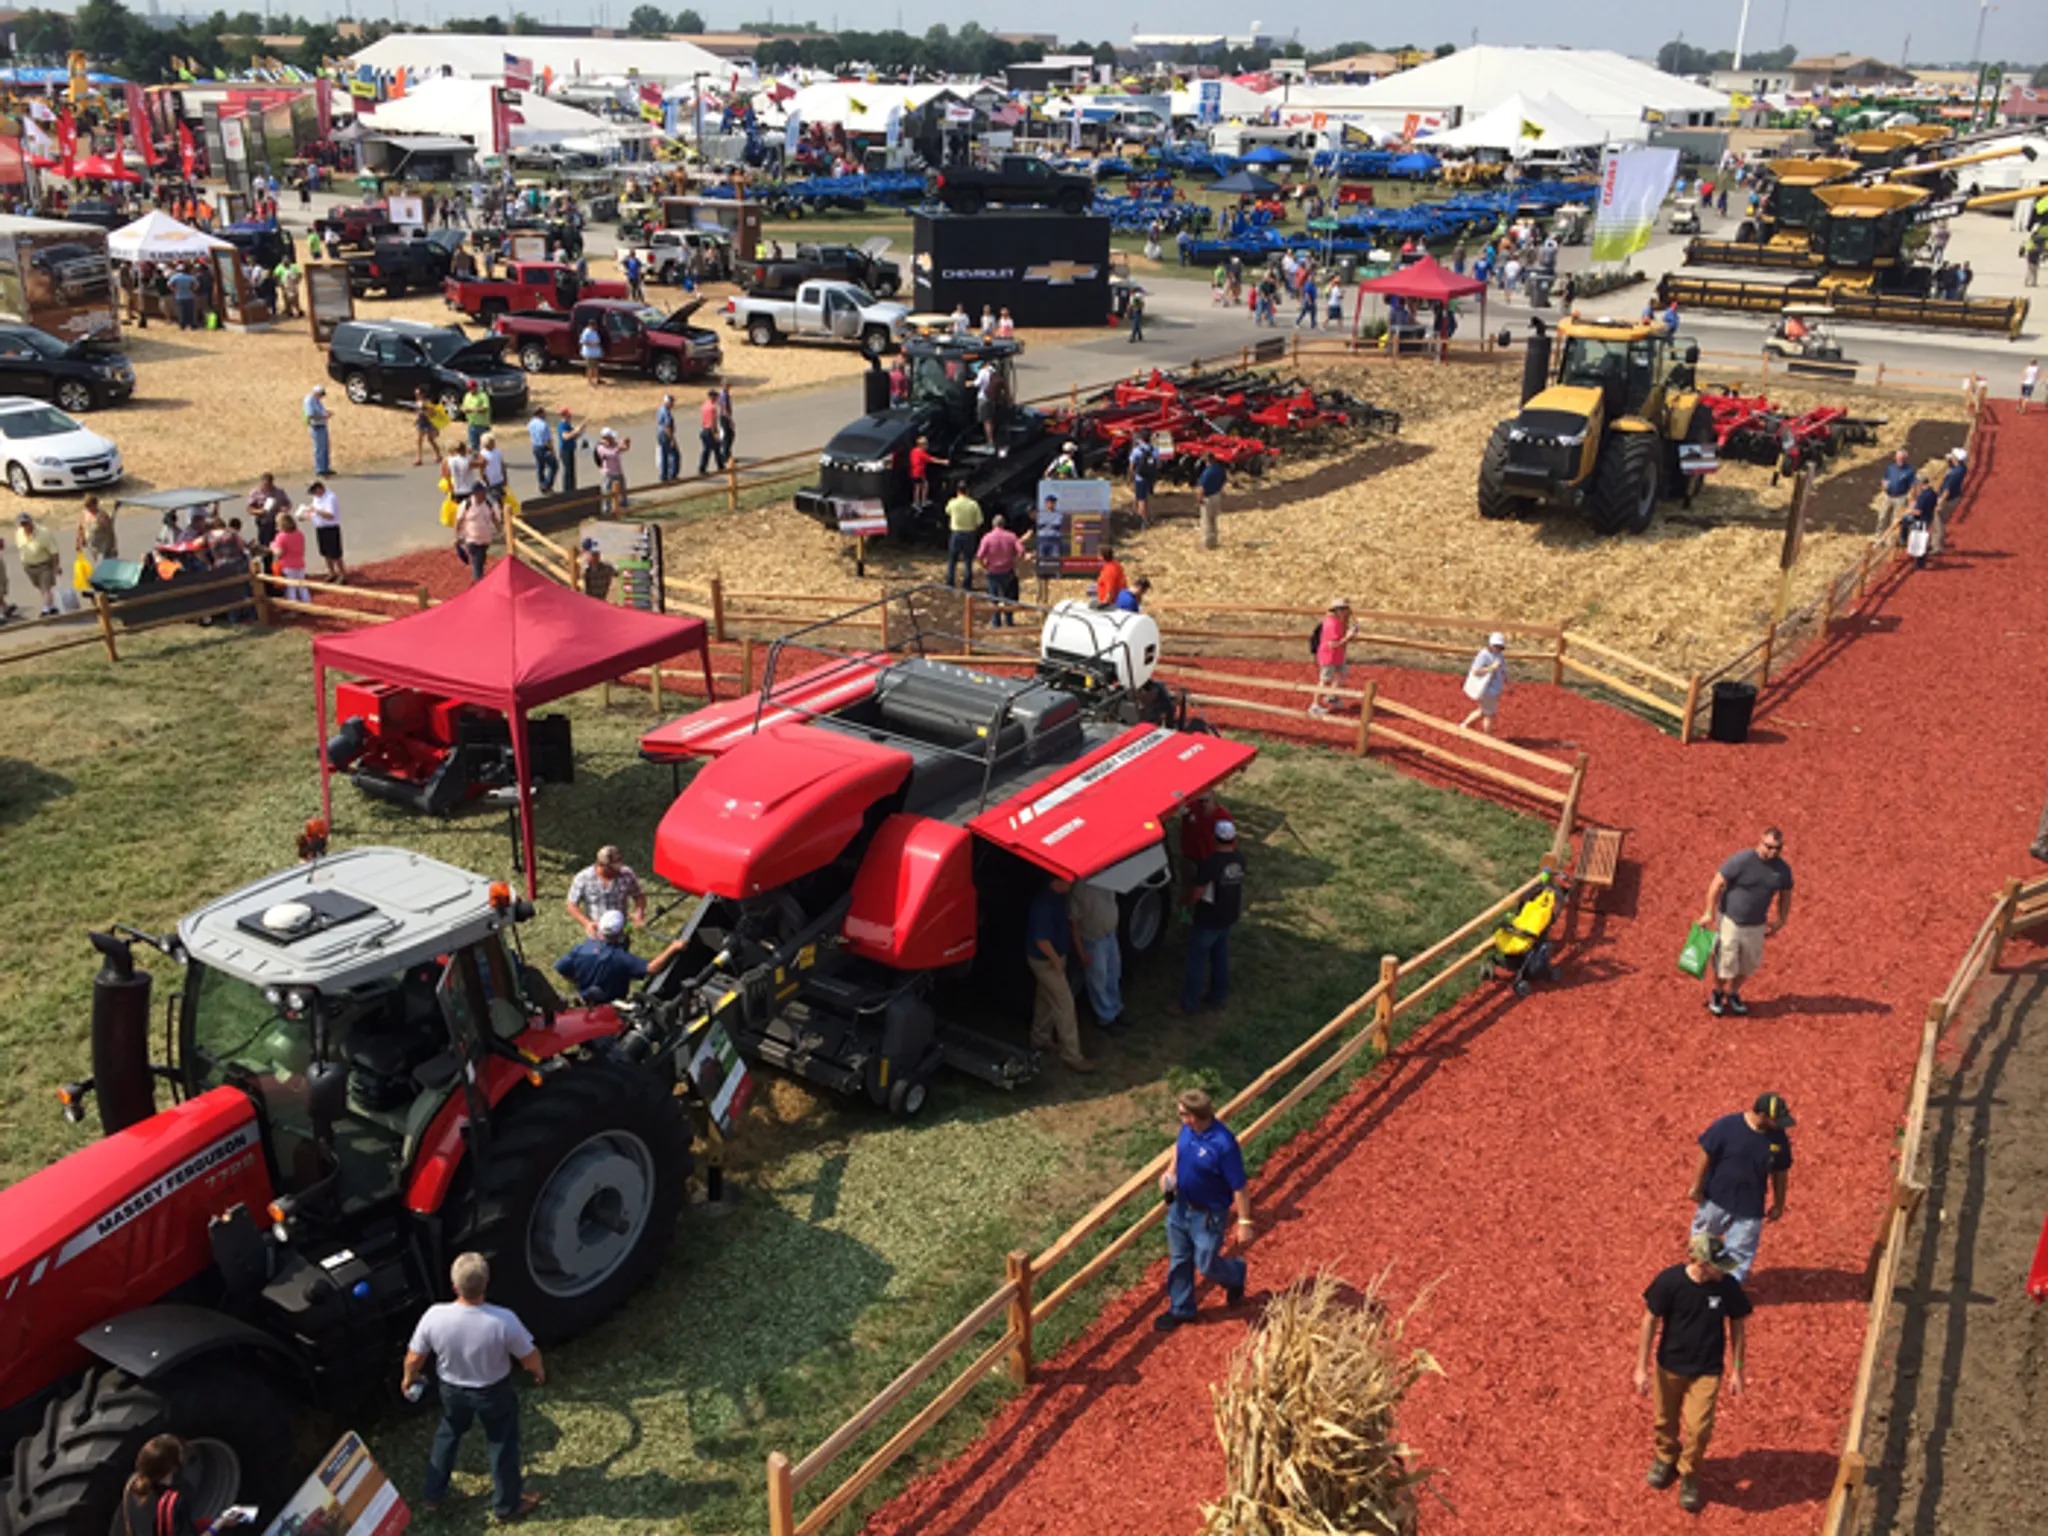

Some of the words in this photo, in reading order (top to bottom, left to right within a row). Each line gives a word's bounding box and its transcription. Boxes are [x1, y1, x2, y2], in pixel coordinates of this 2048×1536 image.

[941, 268, 1015, 280] CHEVROLET
[97, 1183, 164, 1235] MASSEY
[165, 1133, 248, 1190] FERGUSON
